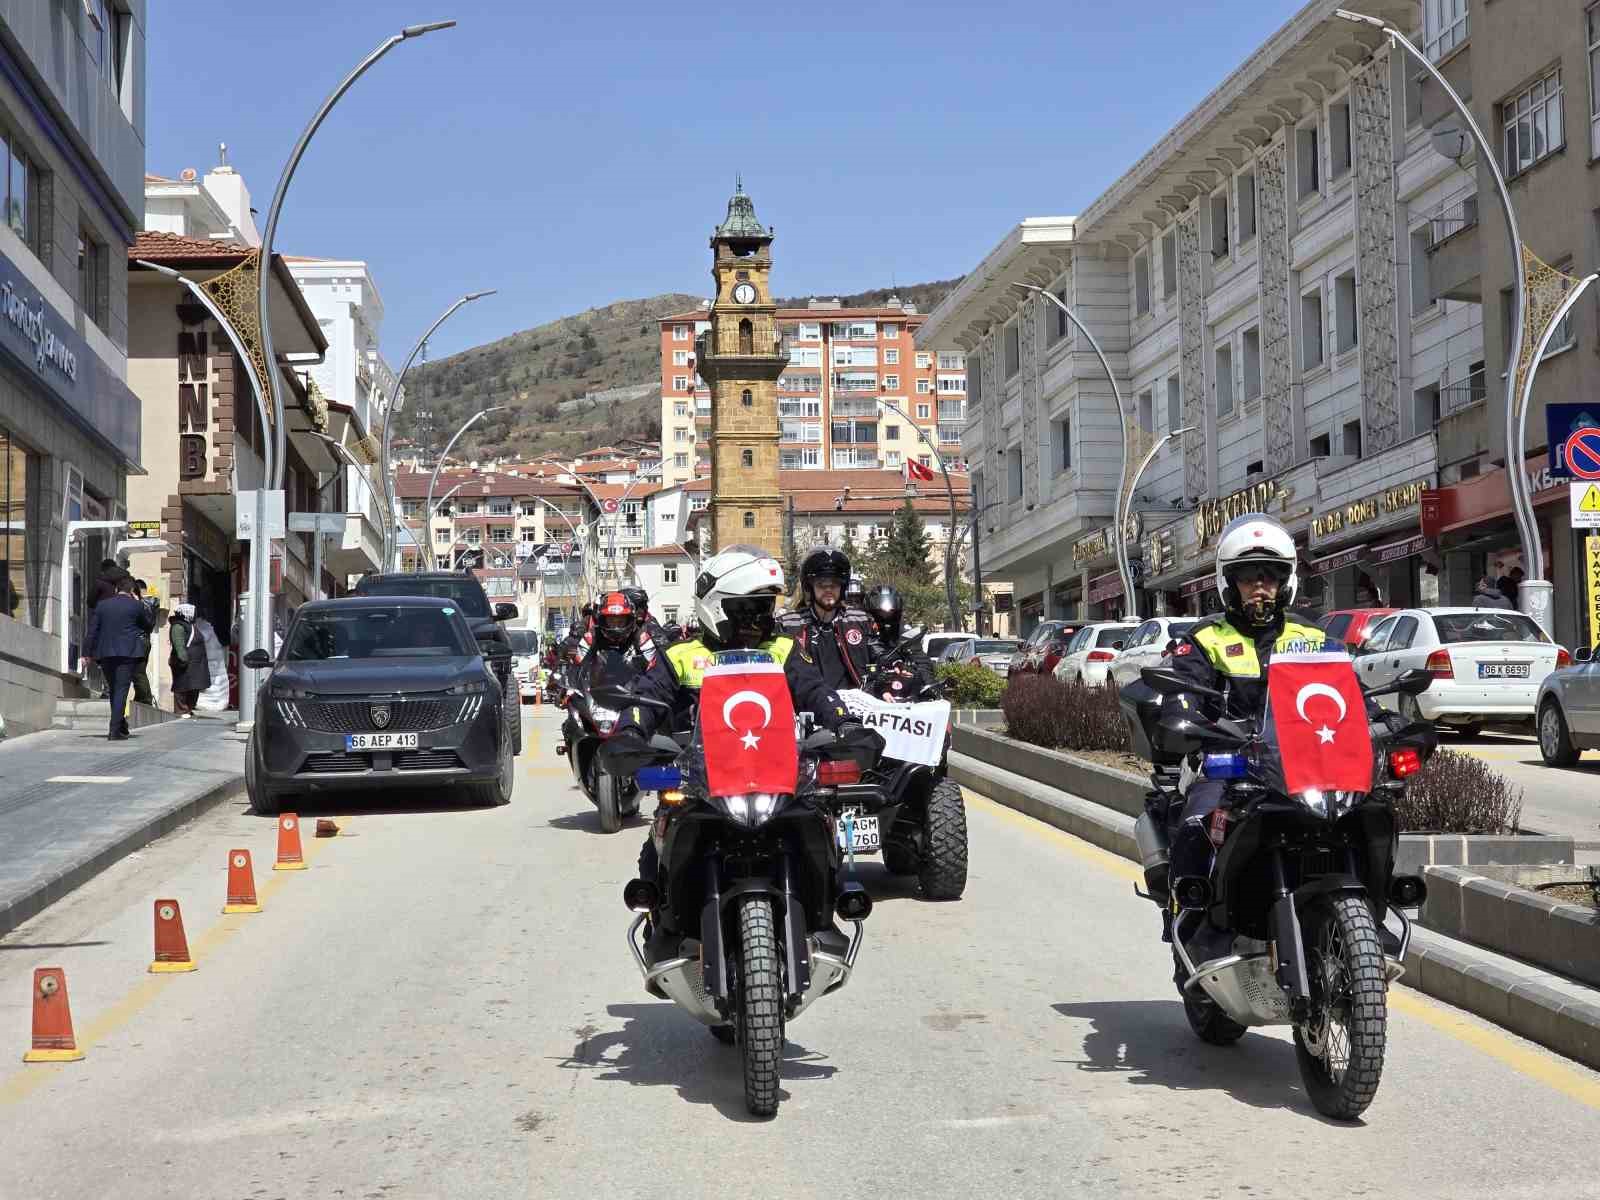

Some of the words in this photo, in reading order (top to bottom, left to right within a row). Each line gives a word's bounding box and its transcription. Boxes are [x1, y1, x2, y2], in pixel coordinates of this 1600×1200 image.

[864, 711, 933, 738] AFTASI
[352, 735, 366, 747] 66
[371, 735, 391, 747] AEP
[397, 734, 416, 746] 413
[852, 818, 877, 831] AGM
[854, 833, 878, 846] 760
